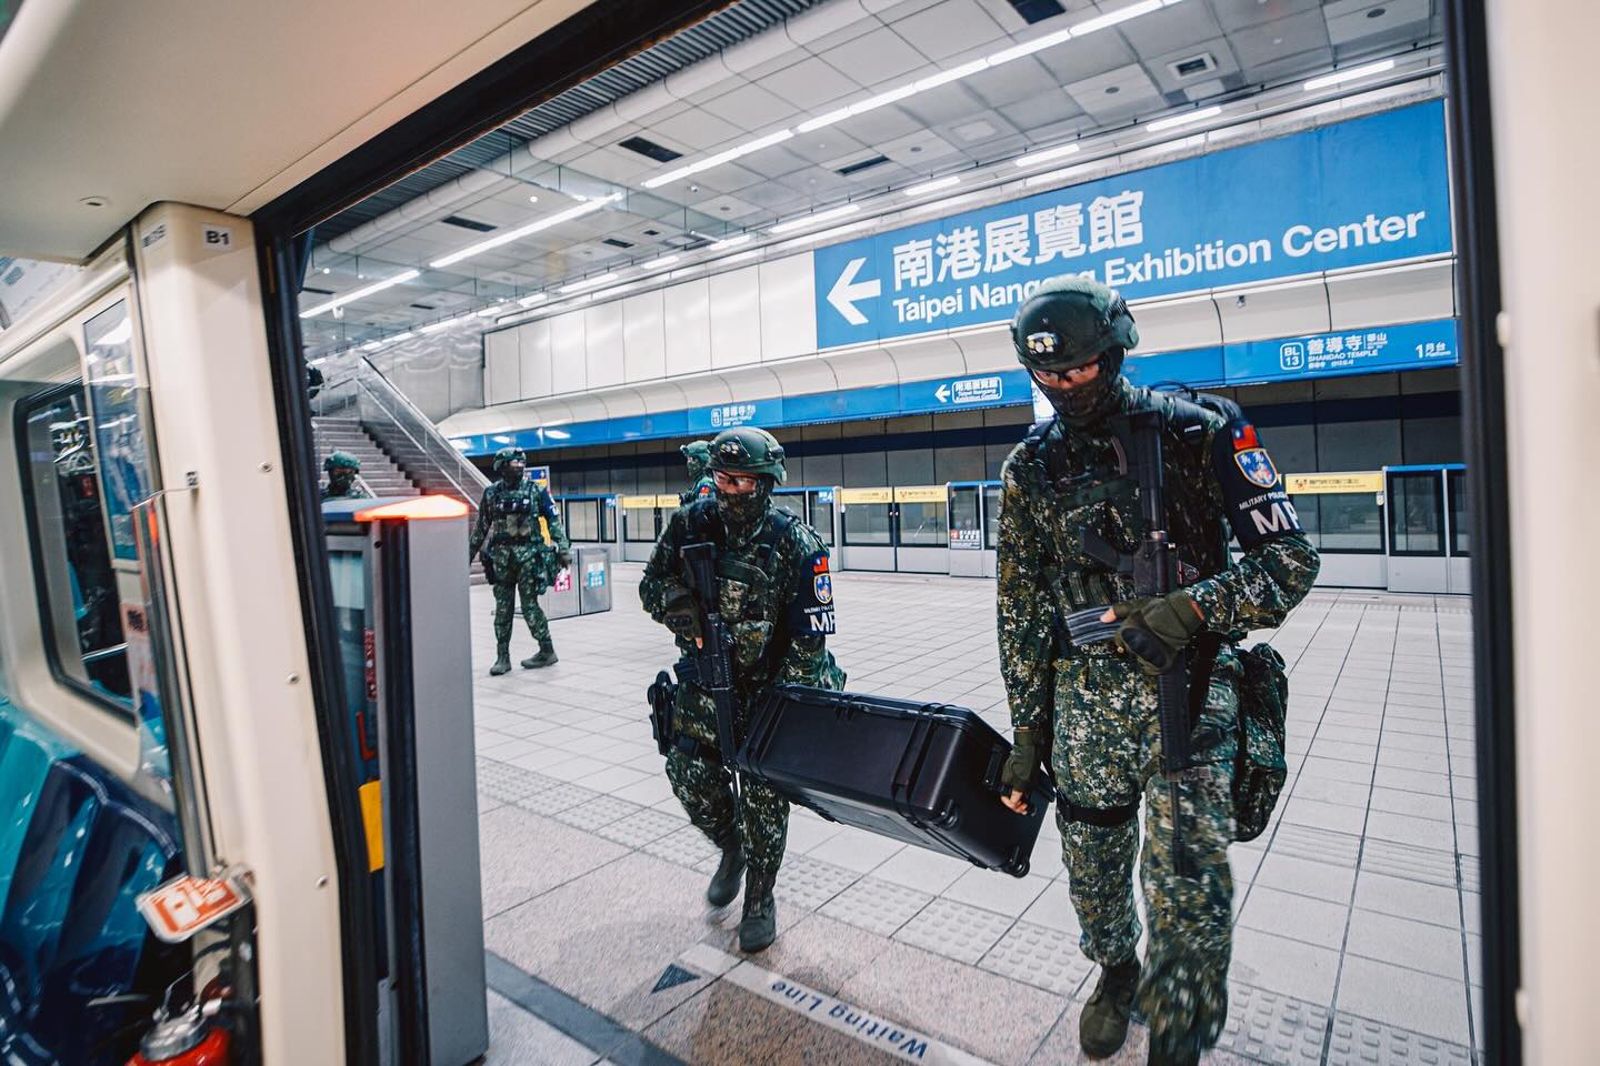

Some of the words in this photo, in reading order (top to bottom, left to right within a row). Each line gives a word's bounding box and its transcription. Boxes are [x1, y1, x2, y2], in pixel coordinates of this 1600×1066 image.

[206, 230, 229, 245] B1
[893, 190, 1144, 291] 南港展覽館
[893, 287, 963, 323] Taipei
[1105, 238, 1272, 287] Exhibition
[1282, 211, 1425, 257] Center
[1284, 347, 1300, 357] BL
[1347, 349, 1378, 358] TEMPLE
[1285, 356, 1299, 366] 13
[1239, 493, 1268, 510] MILITARY
[771, 980, 823, 1012] Line
[828, 1003, 928, 1059] Waiting
